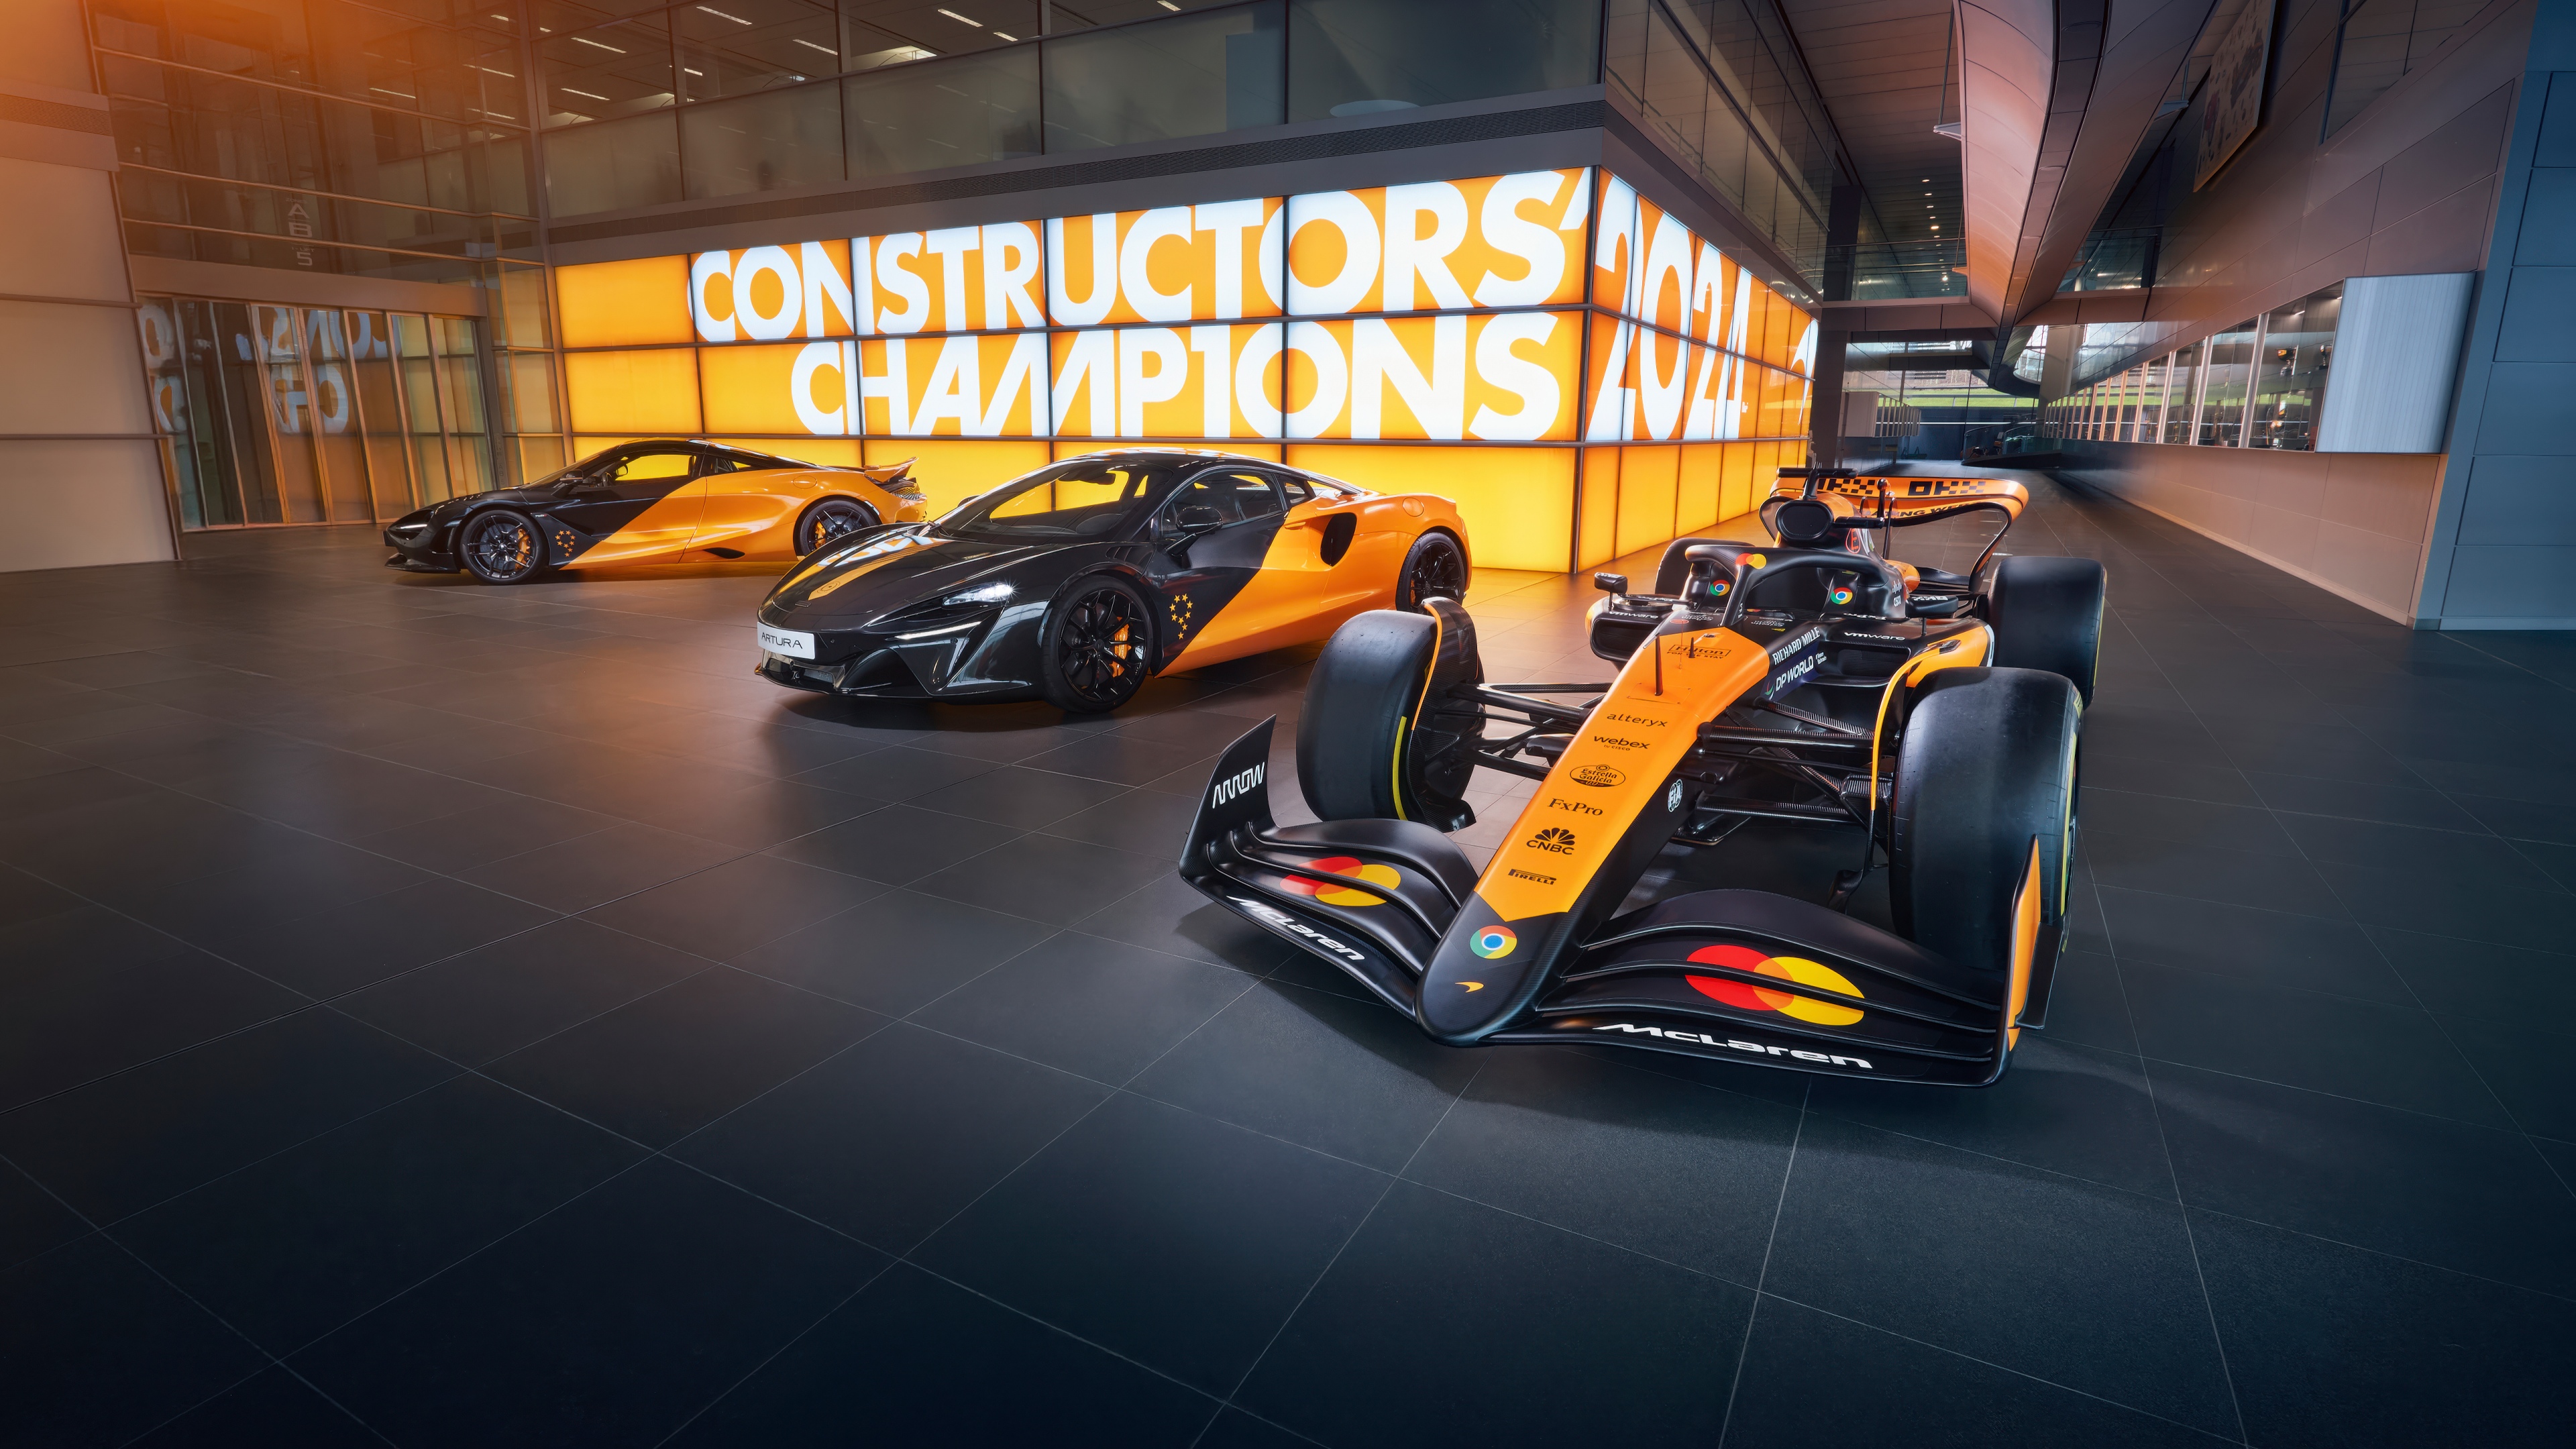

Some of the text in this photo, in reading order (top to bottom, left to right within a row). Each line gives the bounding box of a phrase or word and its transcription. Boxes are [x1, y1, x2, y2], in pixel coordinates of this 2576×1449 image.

[1585, 176, 1752, 440] 2024
[761, 632, 803, 649] ARTURA
[1844, 632, 1906, 641] vmware
[1772, 626, 1821, 665] RICHARD MILLE
[1776, 655, 1814, 692] DP WORLD
[1607, 714, 1668, 727] alteryx
[1594, 735, 1651, 749] webex
[1579, 773, 1613, 784] Galicia
[1580, 768, 1617, 779] Estrella
[1212, 762, 1265, 809] ARROW
[1548, 798, 1603, 816] FxPro
[1526, 839, 1575, 855] CNBC
[1508, 869, 1557, 885] PIRELLI
[1226, 895, 1365, 961] McLaren
[1593, 1024, 1873, 1069] McLaren
